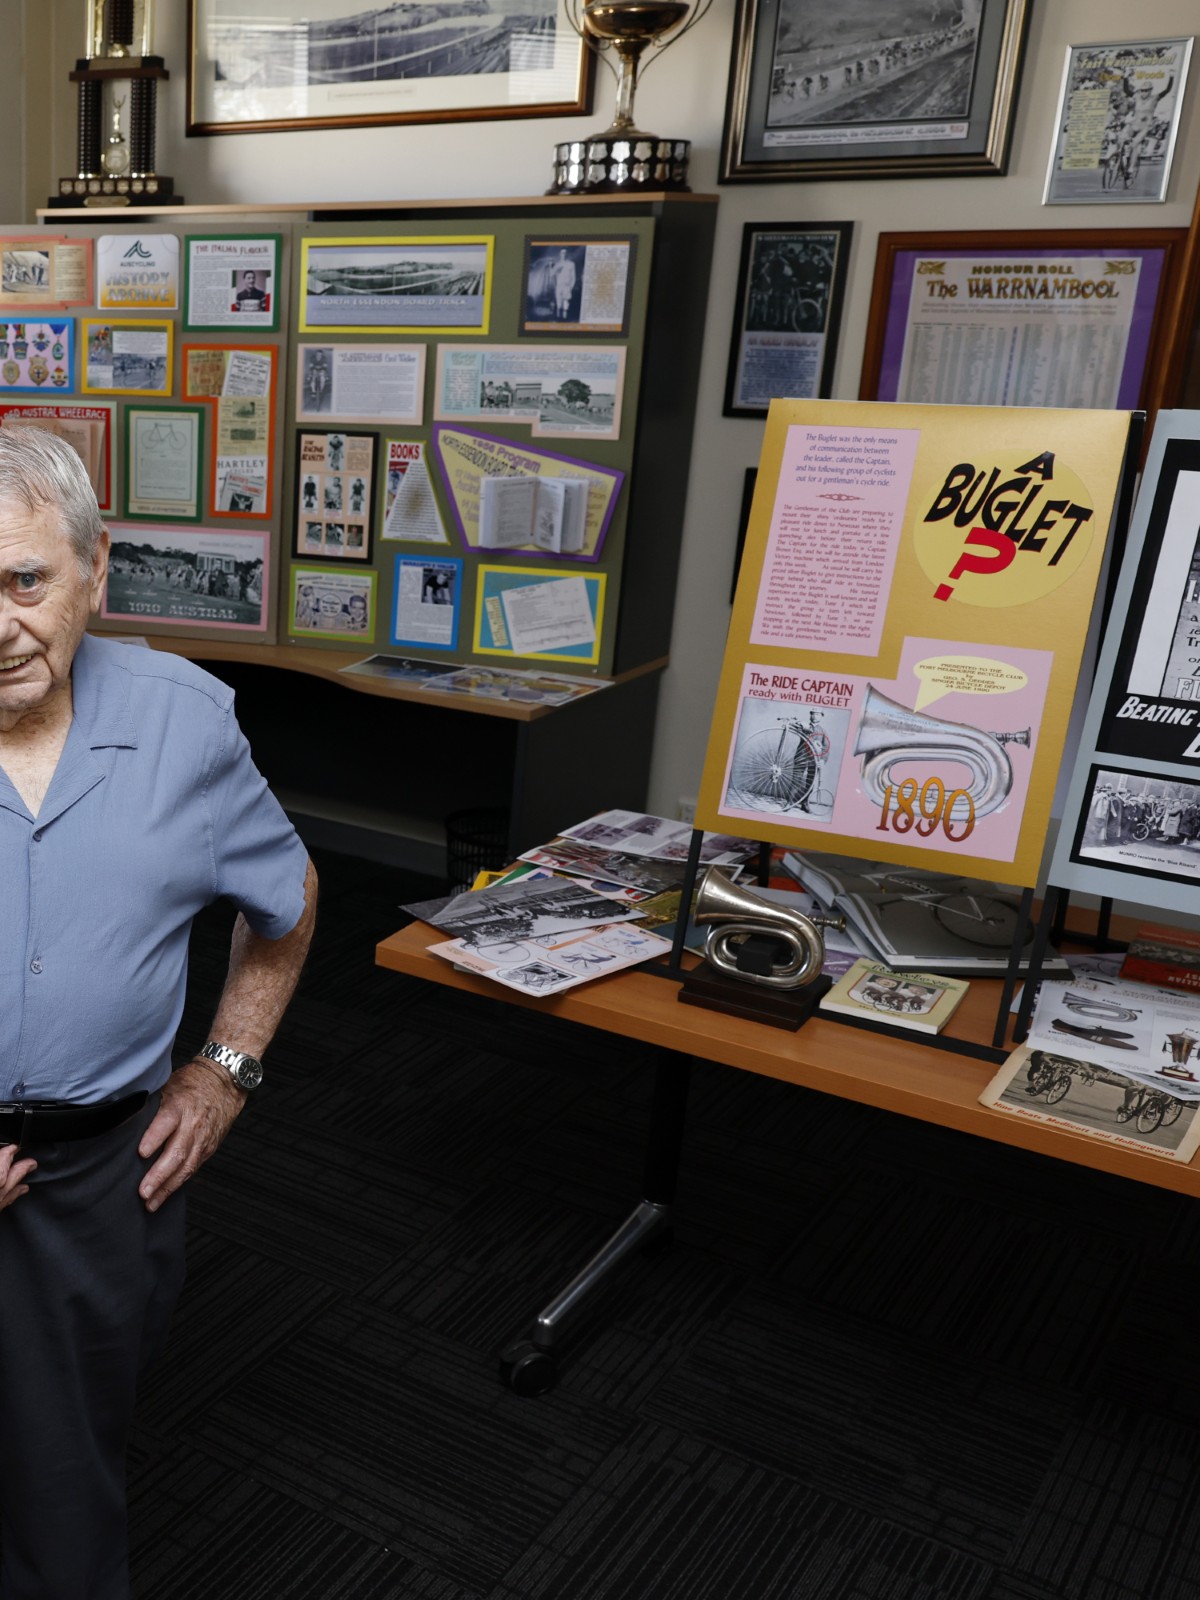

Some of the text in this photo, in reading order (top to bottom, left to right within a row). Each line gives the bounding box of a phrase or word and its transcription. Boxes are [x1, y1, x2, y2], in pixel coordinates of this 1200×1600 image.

[971, 264, 1075, 275] HONOUR ROLL
[105, 271, 170, 286] HISTORY
[105, 288, 169, 302] ARCHIVE
[927, 277, 1120, 300] The WARRNAMBOOL
[817, 434, 837, 443] Buglet
[863, 436, 876, 444] only
[390, 443, 420, 459] BOOKS
[817, 445, 862, 453] communication
[217, 459, 265, 469] HARTLEY
[497, 446, 541, 474] Program
[835, 455, 853, 463] called
[1014, 450, 1055, 480] A
[817, 465, 844, 474] following
[873, 468, 896, 477] cyclists
[860, 478, 876, 486] cycle
[923, 462, 1093, 567] BUGLET
[128, 601, 237, 620] 1910 AUSTRAL
[750, 672, 854, 696] The RIDE CAPTAIN
[748, 687, 850, 708] ready with BUGLET
[1116, 696, 1198, 727] BEATING
[876, 776, 975, 842] 1890
[993, 1102, 1175, 1157] Hine Beats Medlicott and Hollingworth
